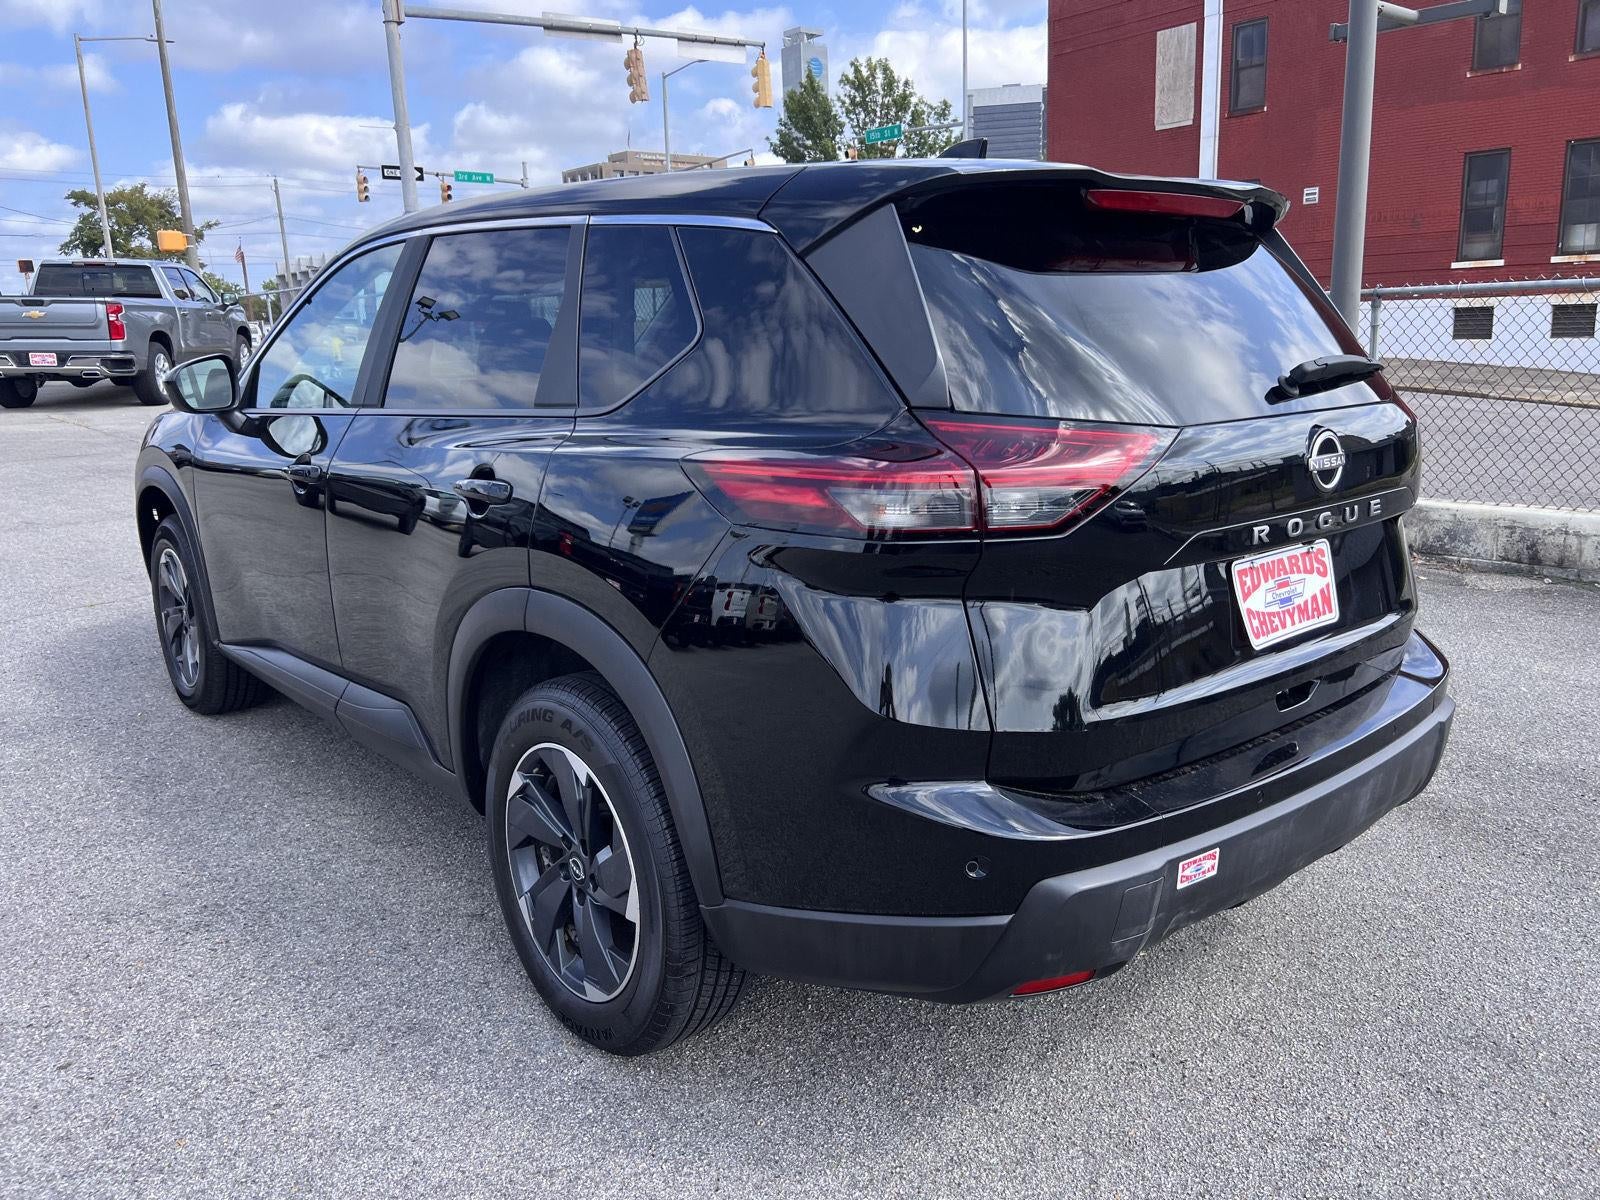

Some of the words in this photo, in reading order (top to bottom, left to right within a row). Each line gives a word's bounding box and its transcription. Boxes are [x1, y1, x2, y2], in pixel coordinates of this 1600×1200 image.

[458, 173, 468, 181] 3rd
[472, 174, 482, 182] Ave
[1310, 454, 1345, 470] NISSAN
[1252, 499, 1382, 545] ROGUE
[1237, 548, 1328, 603] EDWARDS
[1272, 587, 1297, 599] Chevrolet
[1246, 582, 1333, 640] CHEVYMAN
[1181, 851, 1217, 873] EDWARDS
[1181, 862, 1216, 884] CHEVYMAN
